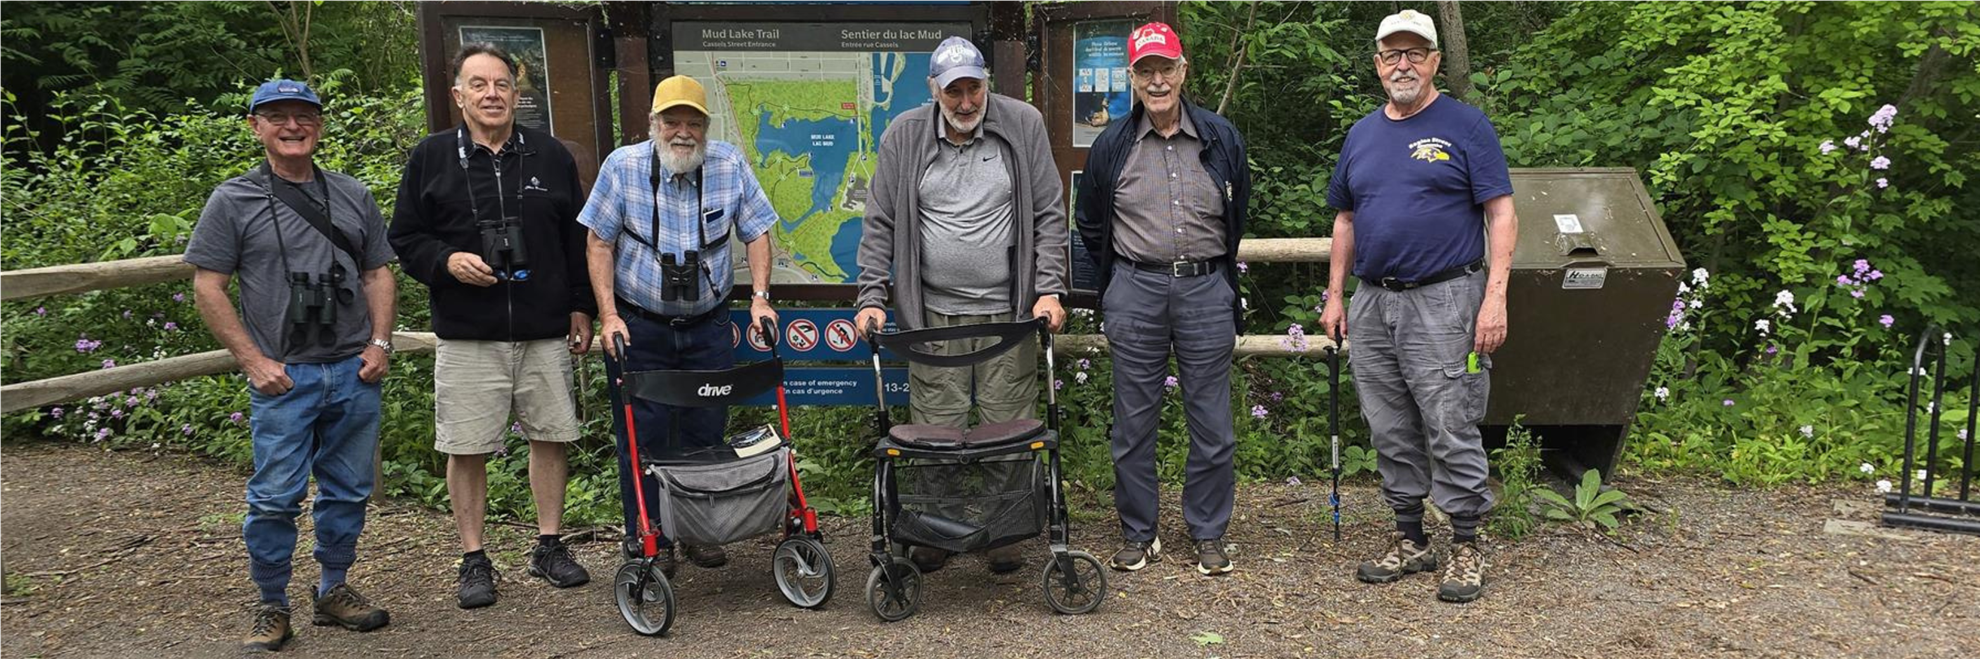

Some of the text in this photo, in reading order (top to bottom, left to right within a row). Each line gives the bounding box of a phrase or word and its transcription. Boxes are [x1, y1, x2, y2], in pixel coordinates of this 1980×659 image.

[702, 29, 780, 39] Mud Lake Trail
[841, 29, 942, 39] Sentier du lac Mud
[698, 383, 732, 396] drive
